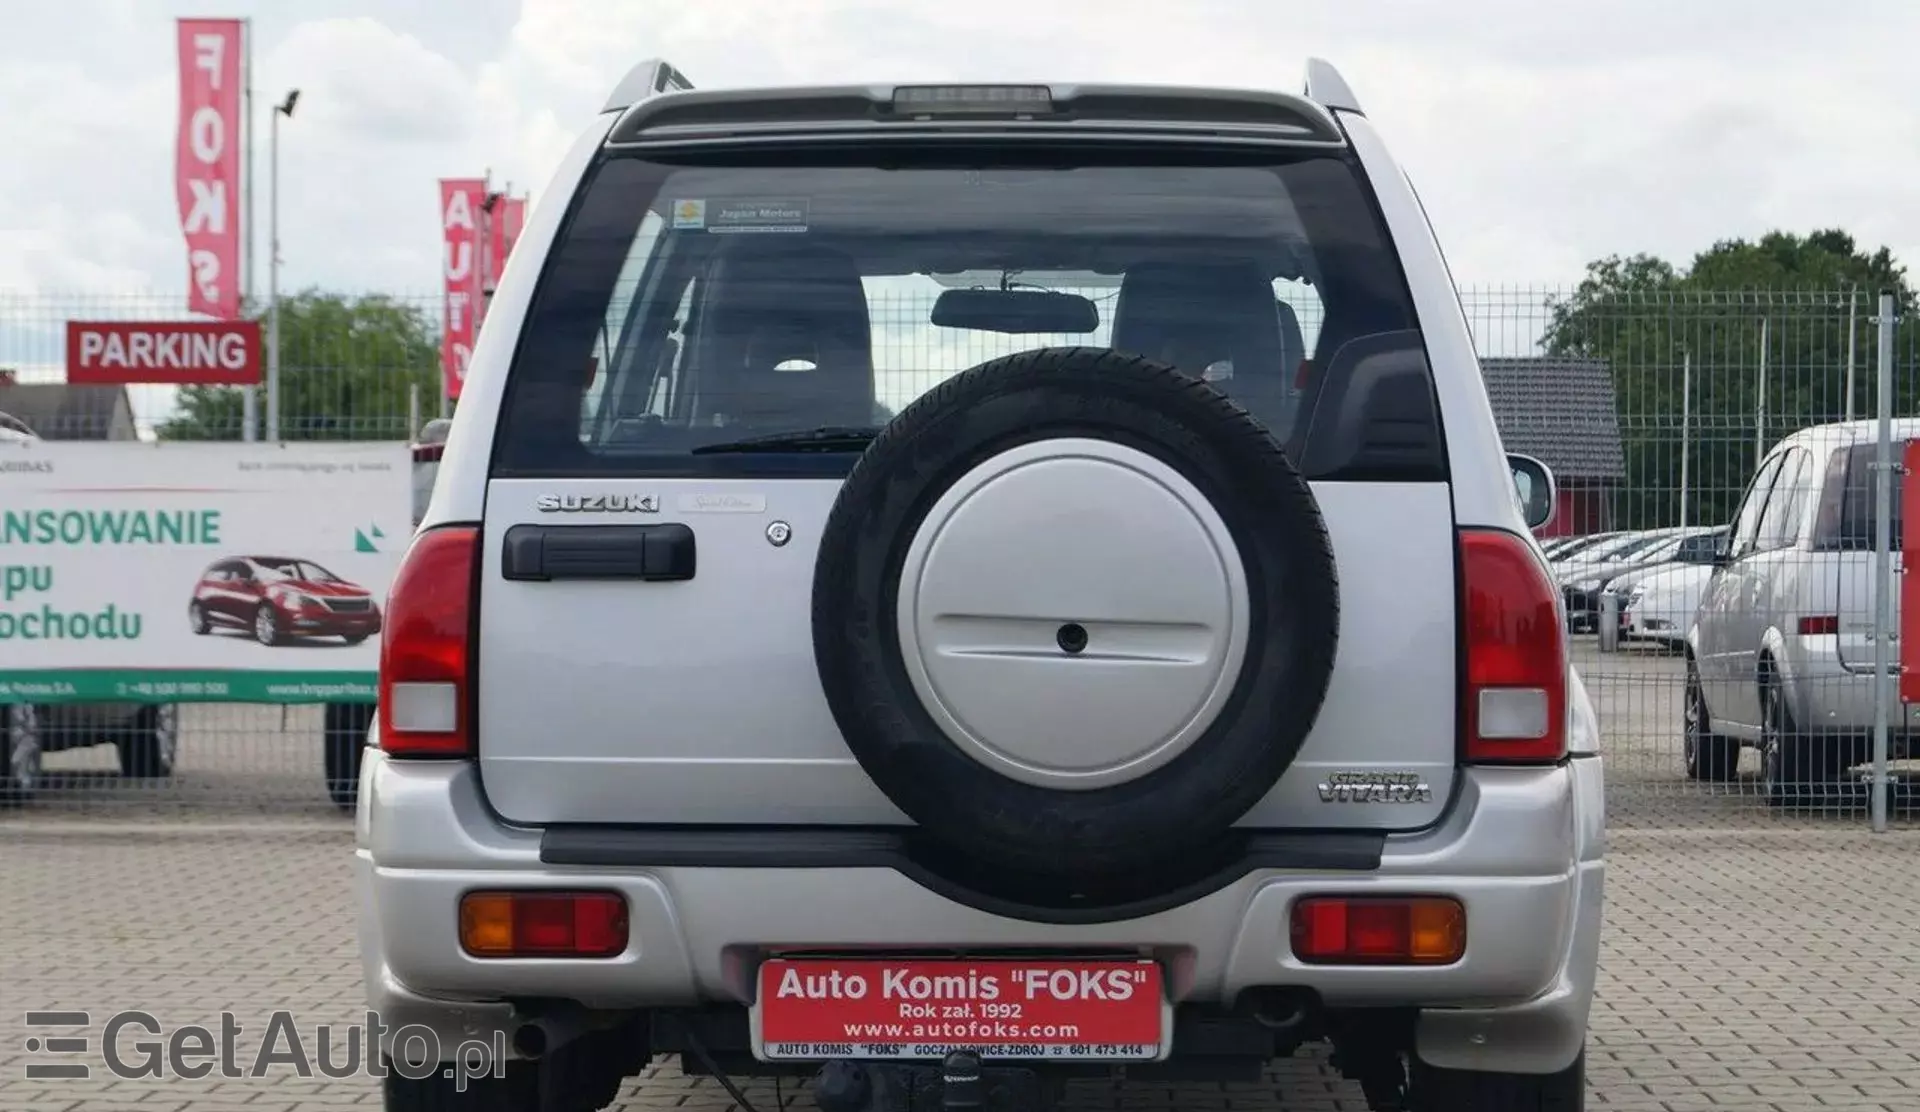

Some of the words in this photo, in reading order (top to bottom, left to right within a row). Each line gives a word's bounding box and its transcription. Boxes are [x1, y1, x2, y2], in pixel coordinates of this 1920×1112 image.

[719, 208, 757, 219] Japan
[759, 208, 802, 218] Motors
[80, 332, 247, 370] PARKING
[537, 494, 660, 513] SUZUKI
[0, 511, 221, 544] NSOWANIE
[1328, 771, 1420, 783] GRAND
[1317, 783, 1433, 803] VITARA
[777, 968, 867, 1000] Auto
[883, 968, 999, 1000] Komis
[1011, 969, 1147, 1000] "FOKS"
[899, 1003, 937, 1019] Rok
[942, 1002, 974, 1019] zał.
[980, 1004, 1022, 1019] 1992
[845, 1021, 1079, 1038] www.autofoks.com
[777, 1044, 809, 1055] AUTO
[813, 1044, 853, 1055] KOMIS
[1070, 1045, 1091, 1055] 601
[1095, 1045, 1117, 1055] 473
[1121, 1045, 1142, 1055] 414
